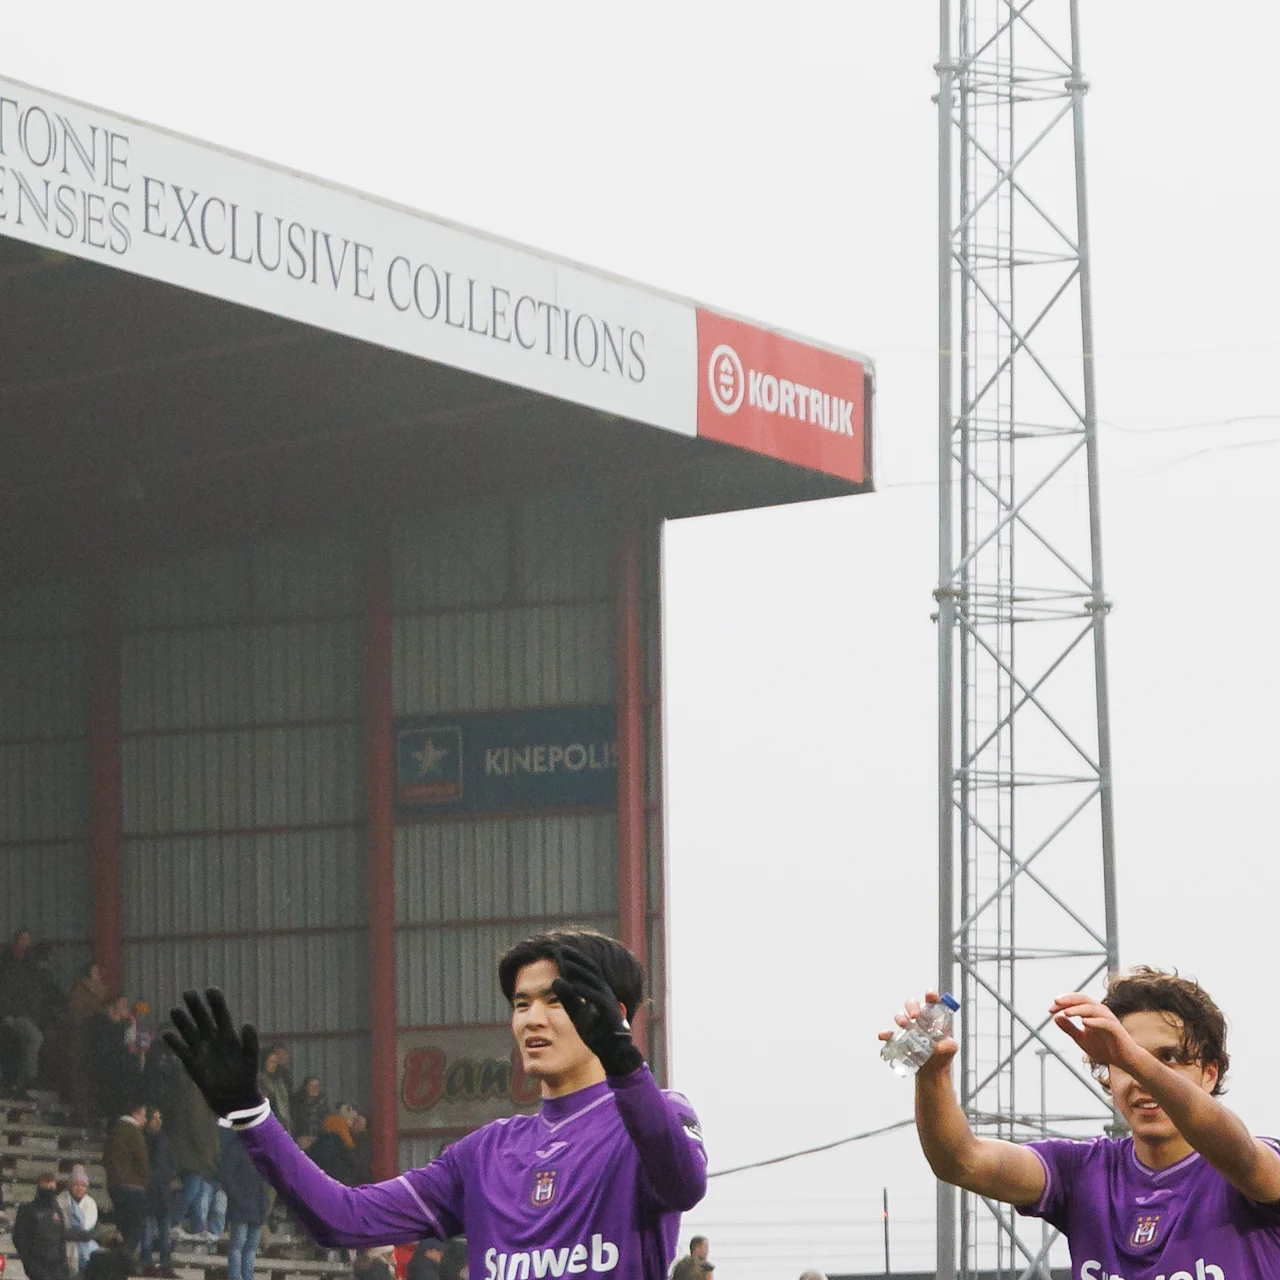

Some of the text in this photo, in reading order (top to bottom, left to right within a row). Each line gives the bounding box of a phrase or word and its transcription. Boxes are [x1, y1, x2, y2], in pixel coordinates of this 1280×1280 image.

[0, 165, 131, 255] NSES
[142, 175, 647, 384] EXCLUSIVE COLLECTIONS
[748, 368, 854, 438] KORTRIJK
